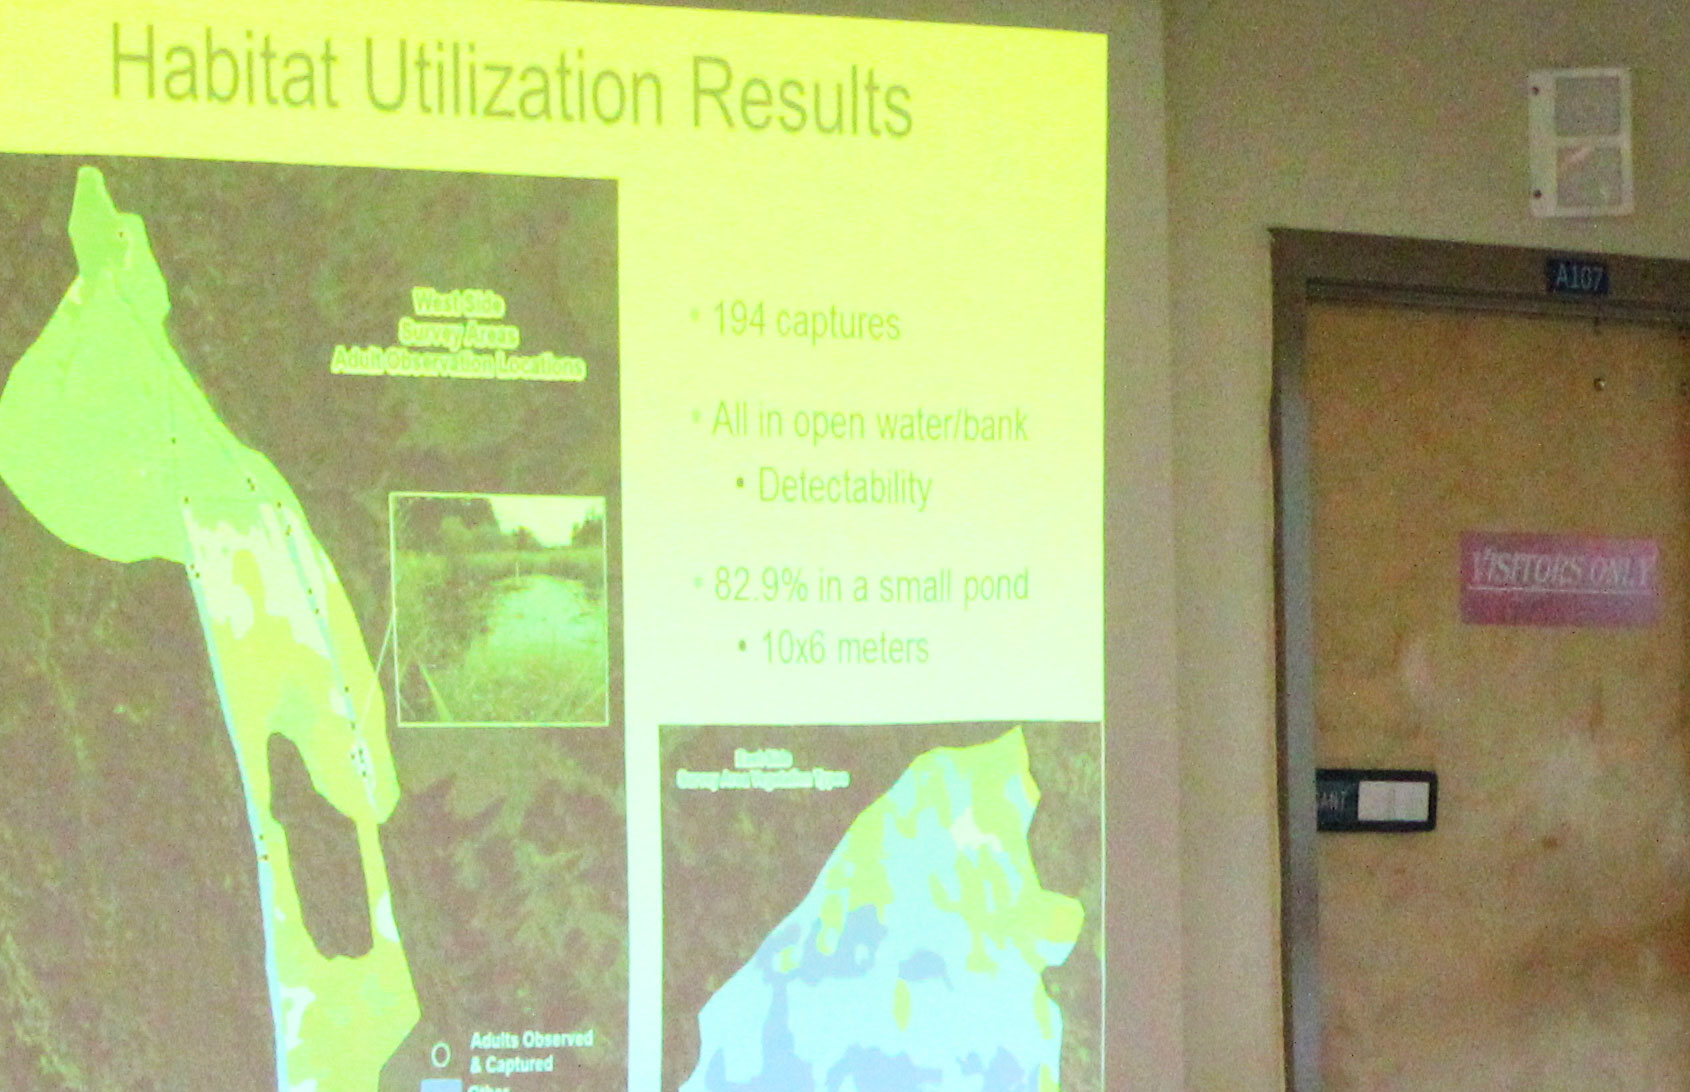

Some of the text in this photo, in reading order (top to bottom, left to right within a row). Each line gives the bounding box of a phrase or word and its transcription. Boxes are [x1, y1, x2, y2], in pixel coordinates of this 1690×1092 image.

[113, 22, 913, 138] Habitat Utilization Results
[1556, 263, 1604, 291] A107
[714, 299, 901, 346] 194 captures
[712, 400, 1029, 447] All in open water/bank
[758, 466, 932, 512] Detectability
[1473, 548, 1658, 586] VISITORS ONLY
[715, 565, 1029, 612] 82.9% in a small pond
[762, 628, 930, 665] 10x6 meters
[470, 1030, 595, 1049] Adults Observed
[470, 1055, 555, 1077] & Captured
